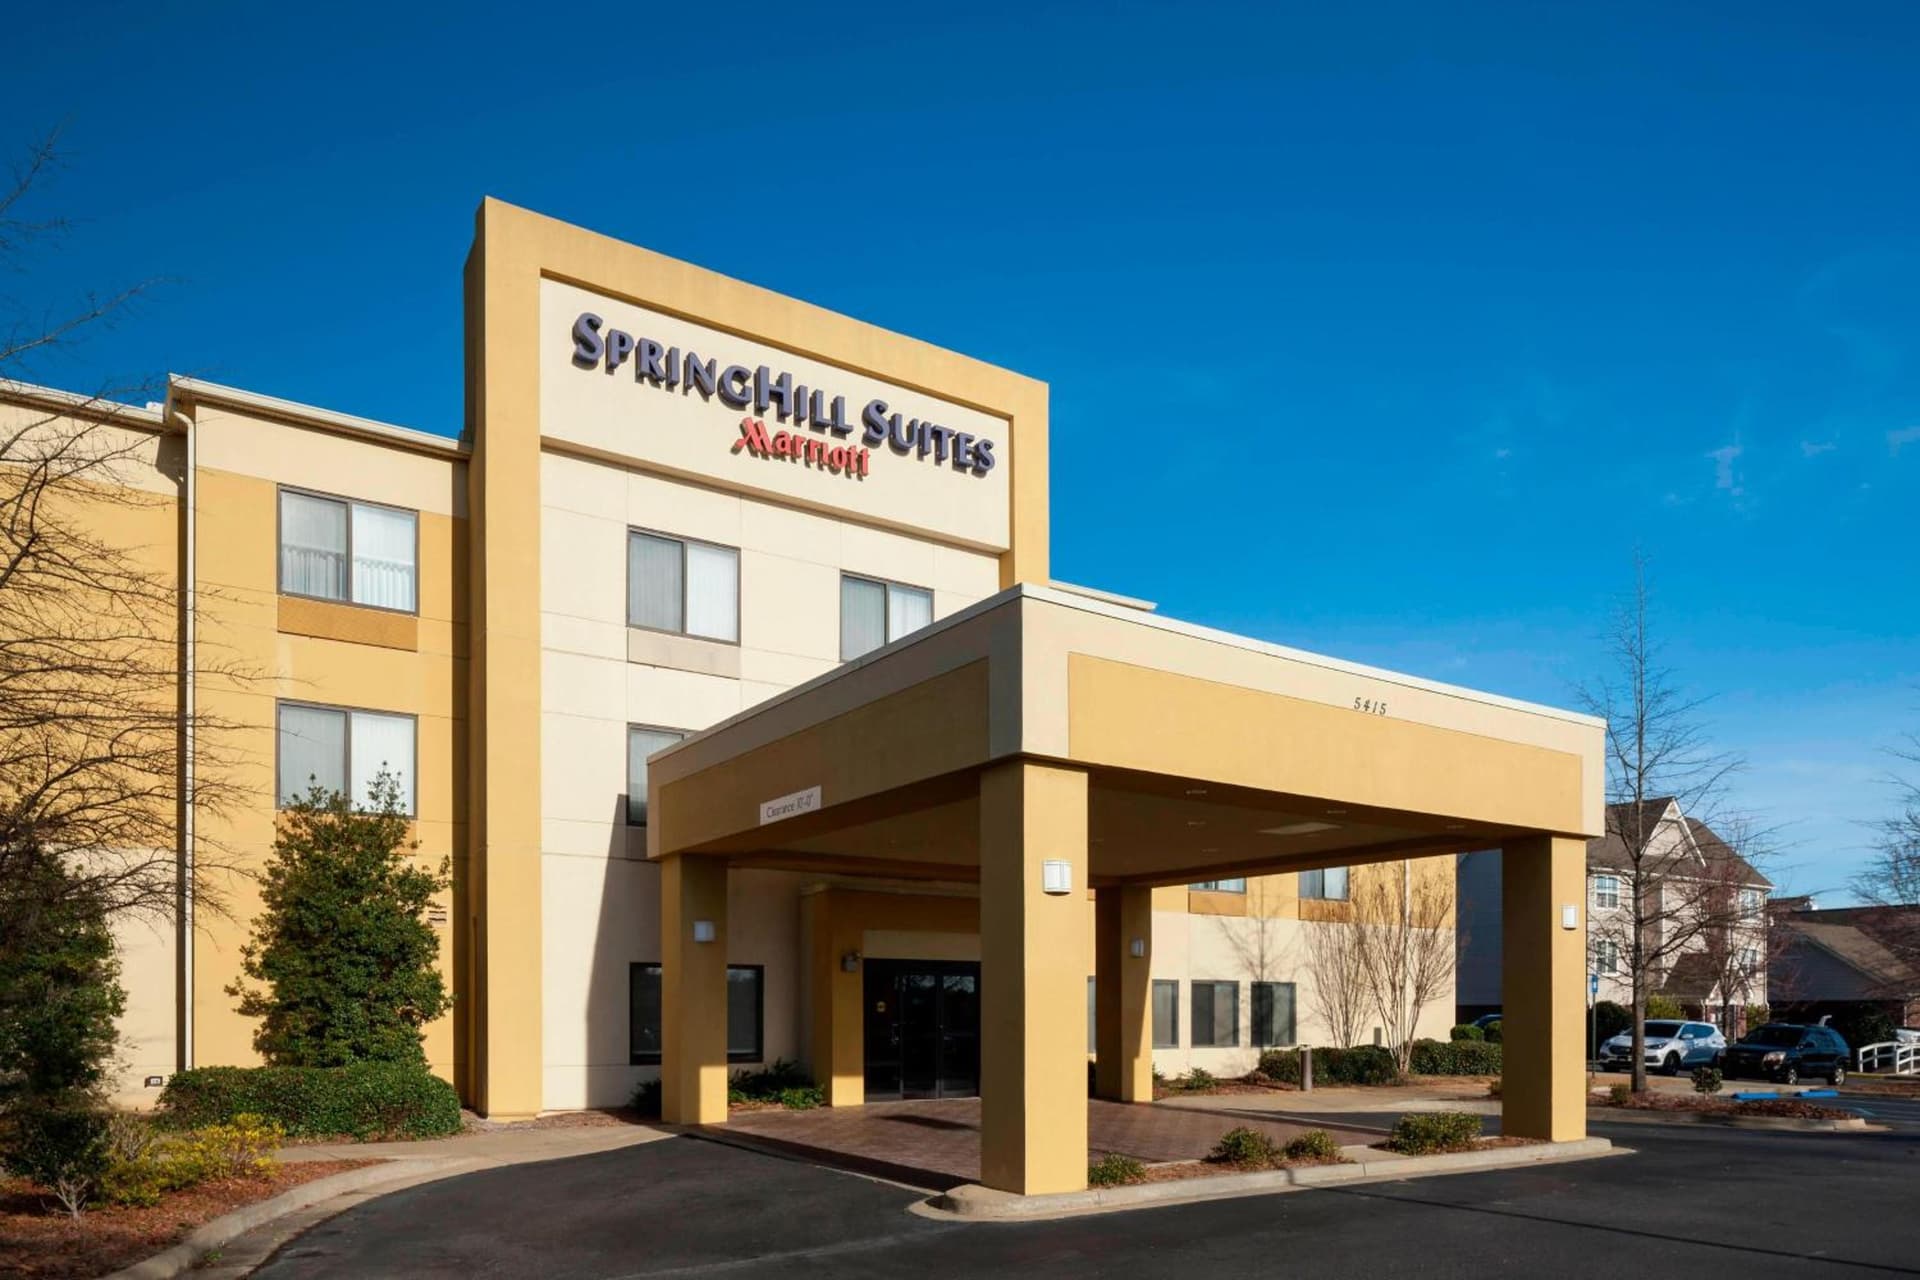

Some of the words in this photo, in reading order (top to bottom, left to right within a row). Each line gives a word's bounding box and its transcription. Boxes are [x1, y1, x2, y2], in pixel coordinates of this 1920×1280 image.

[733, 416, 870, 477] Marriott
[861, 399, 996, 475] SUITES
[1353, 696, 1387, 715] 5415
